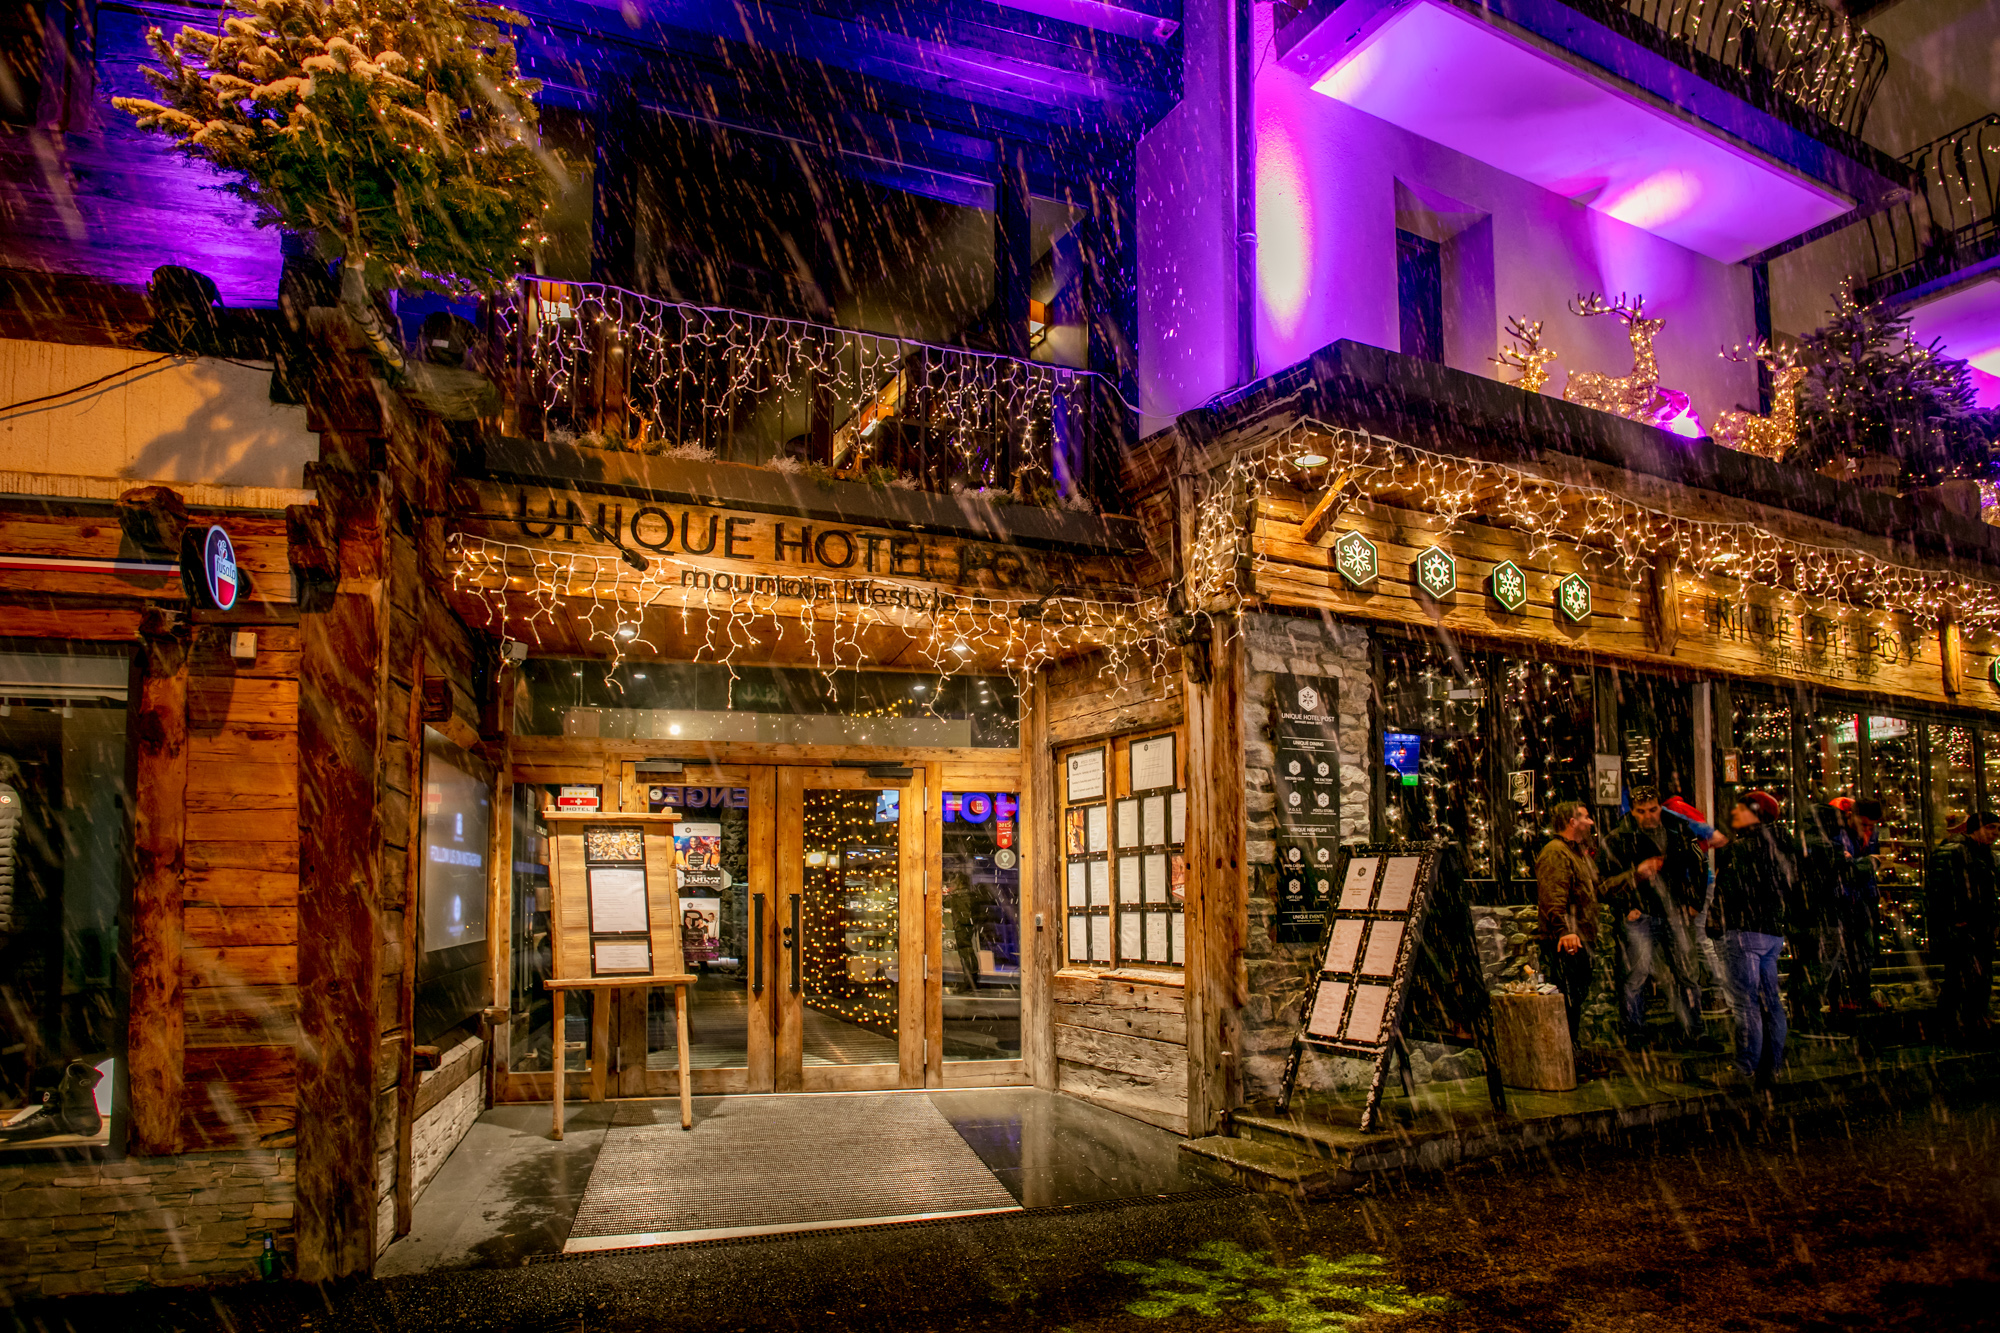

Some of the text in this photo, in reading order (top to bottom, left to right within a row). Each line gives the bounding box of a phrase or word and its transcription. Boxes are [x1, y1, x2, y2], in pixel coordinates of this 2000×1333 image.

[519, 488, 756, 560] UNIQUE
[774, 522, 938, 579] HOTEL
[216, 558, 236, 582] fusalp
[680, 568, 957, 612] mountain lifestyle
